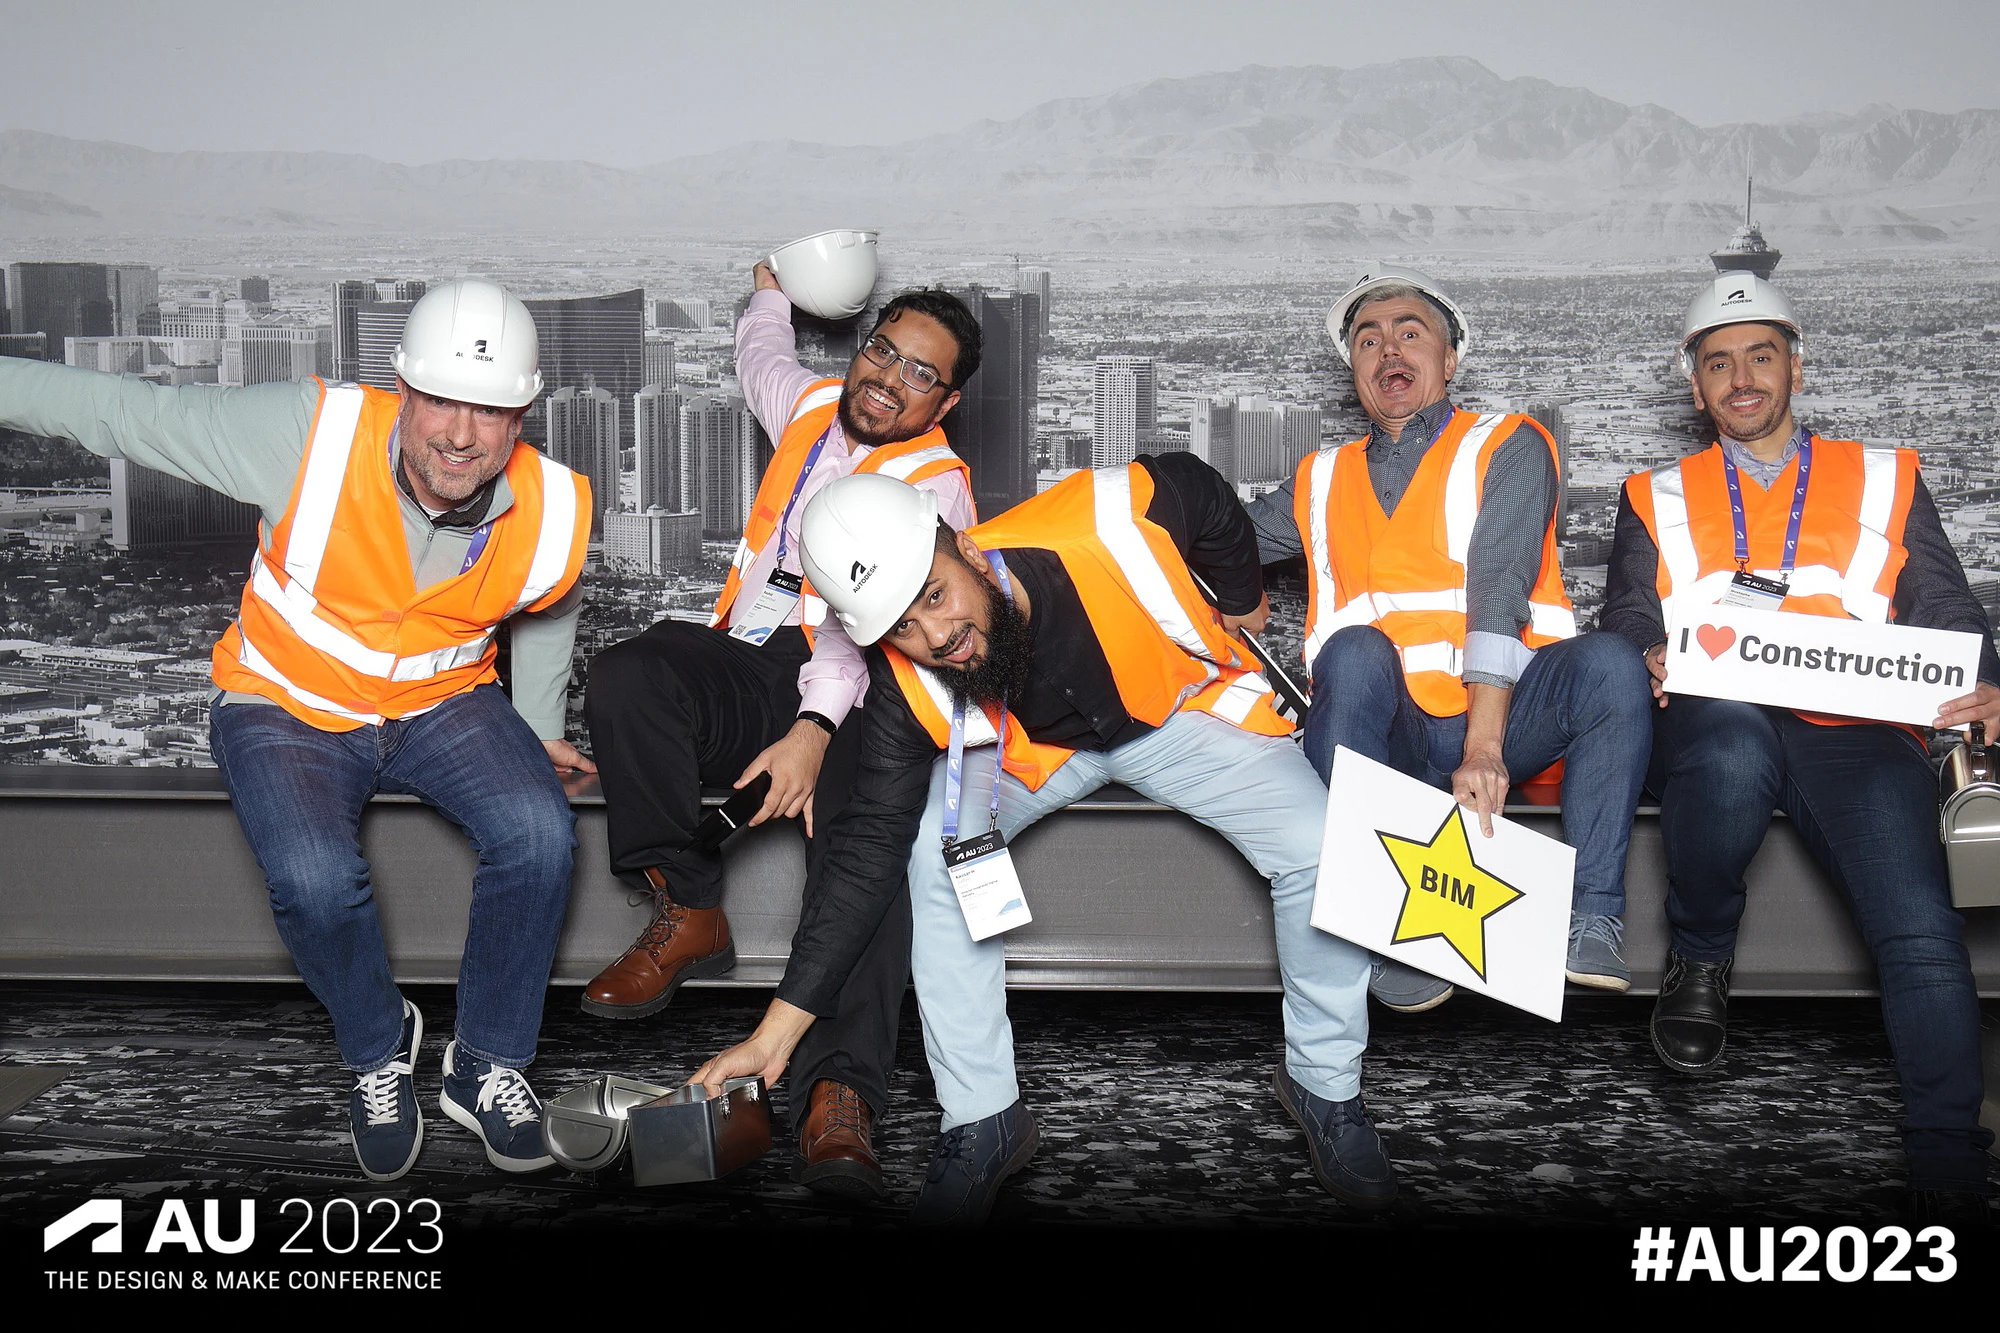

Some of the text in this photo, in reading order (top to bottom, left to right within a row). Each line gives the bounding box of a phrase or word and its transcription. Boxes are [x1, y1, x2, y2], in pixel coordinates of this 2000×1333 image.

[1721, 299, 1753, 307] AUTODESK
[455, 351, 494, 362] ADESK
[853, 563, 878, 593] AUTODESK
[1762, 584, 1778, 592] 2023
[1679, 627, 1964, 687] I Construction
[965, 842, 994, 858] AU 2023
[1420, 864, 1475, 910] BIM
